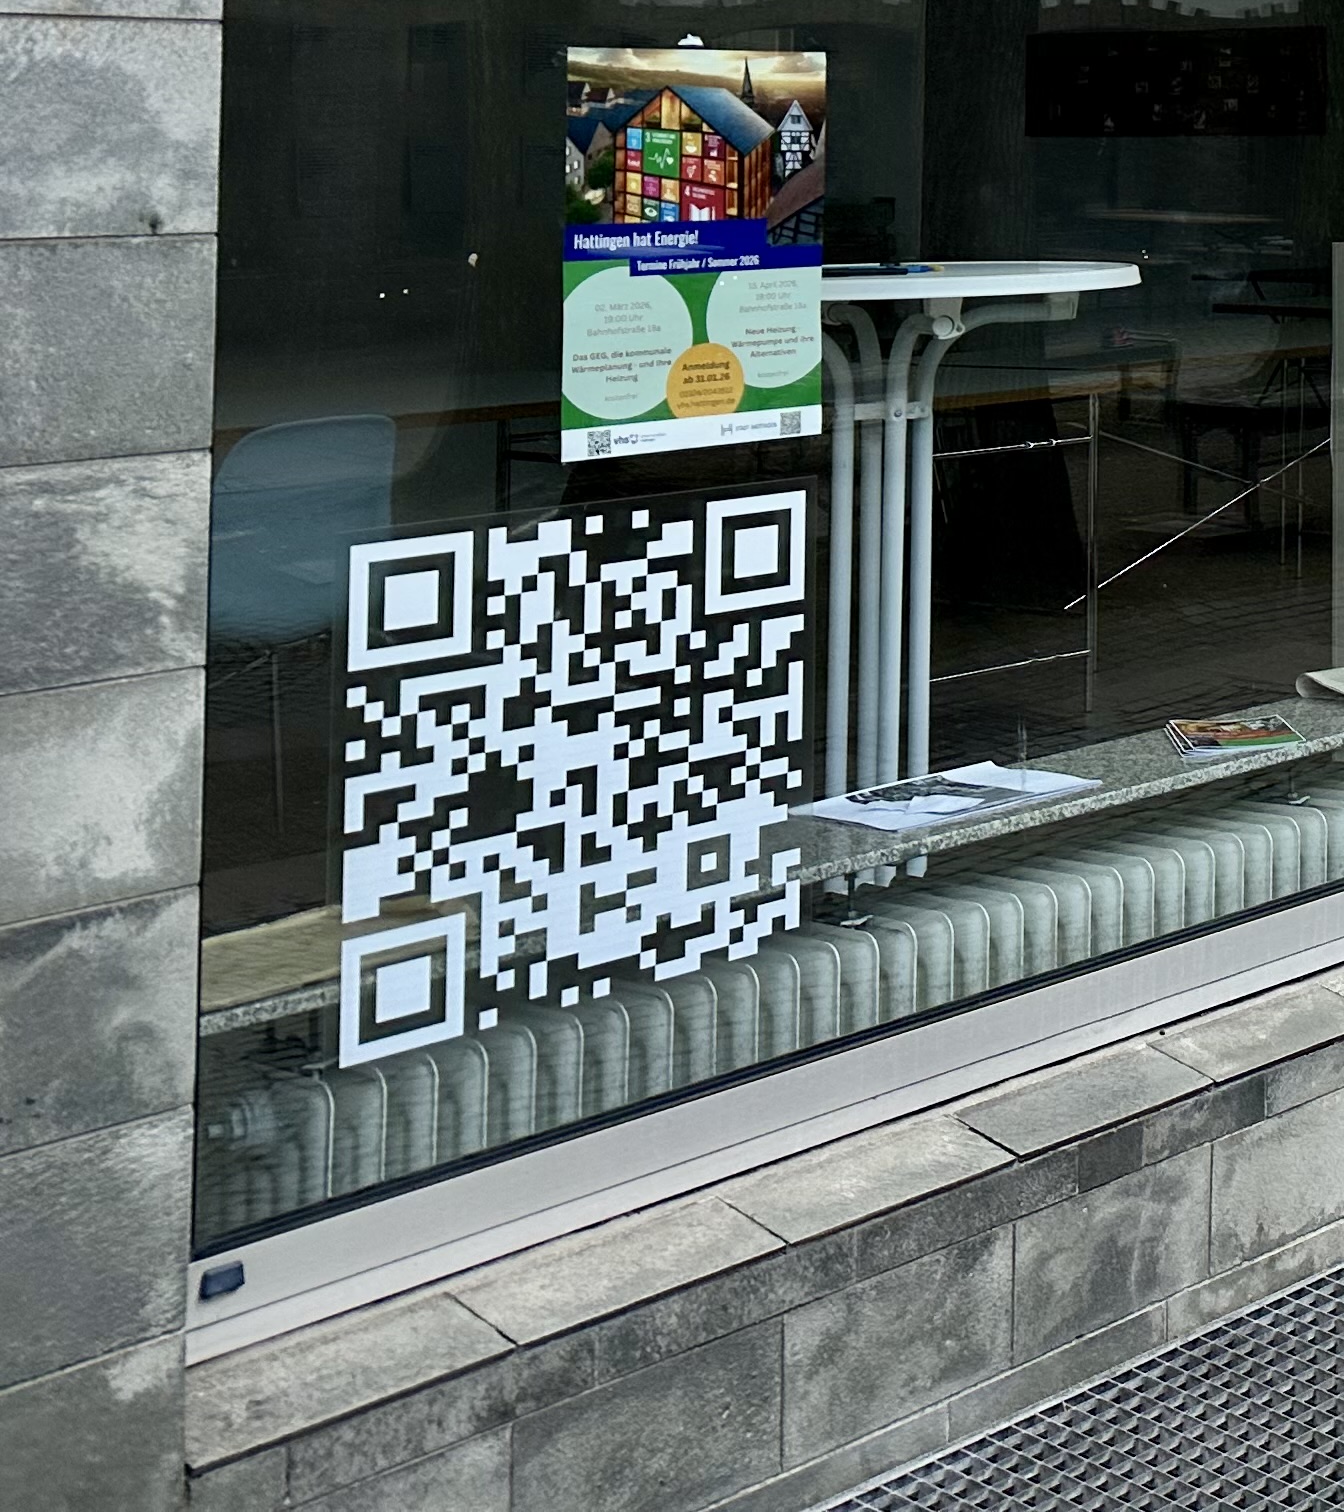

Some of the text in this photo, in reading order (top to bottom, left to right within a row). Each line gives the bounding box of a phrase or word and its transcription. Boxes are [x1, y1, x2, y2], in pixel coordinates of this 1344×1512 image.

[573, 229, 699, 251] Hattingen hat Energie!
[636, 254, 760, 271] Termine Frühjahr / Sommer 2026
[609, 302, 629, 311] März
[629, 314, 644, 322] Uhr
[586, 325, 646, 337] Bahnhofstraße
[784, 336, 798, 344] und
[572, 353, 588, 362] Das
[611, 350, 624, 359] die
[625, 347, 672, 357] kommunale
[750, 348, 797, 358] Alternativen
[571, 362, 633, 373] Wärmeplanung
[639, 360, 654, 368] und
[682, 360, 730, 371] Anmeldung
[605, 374, 638, 383] Heizung
